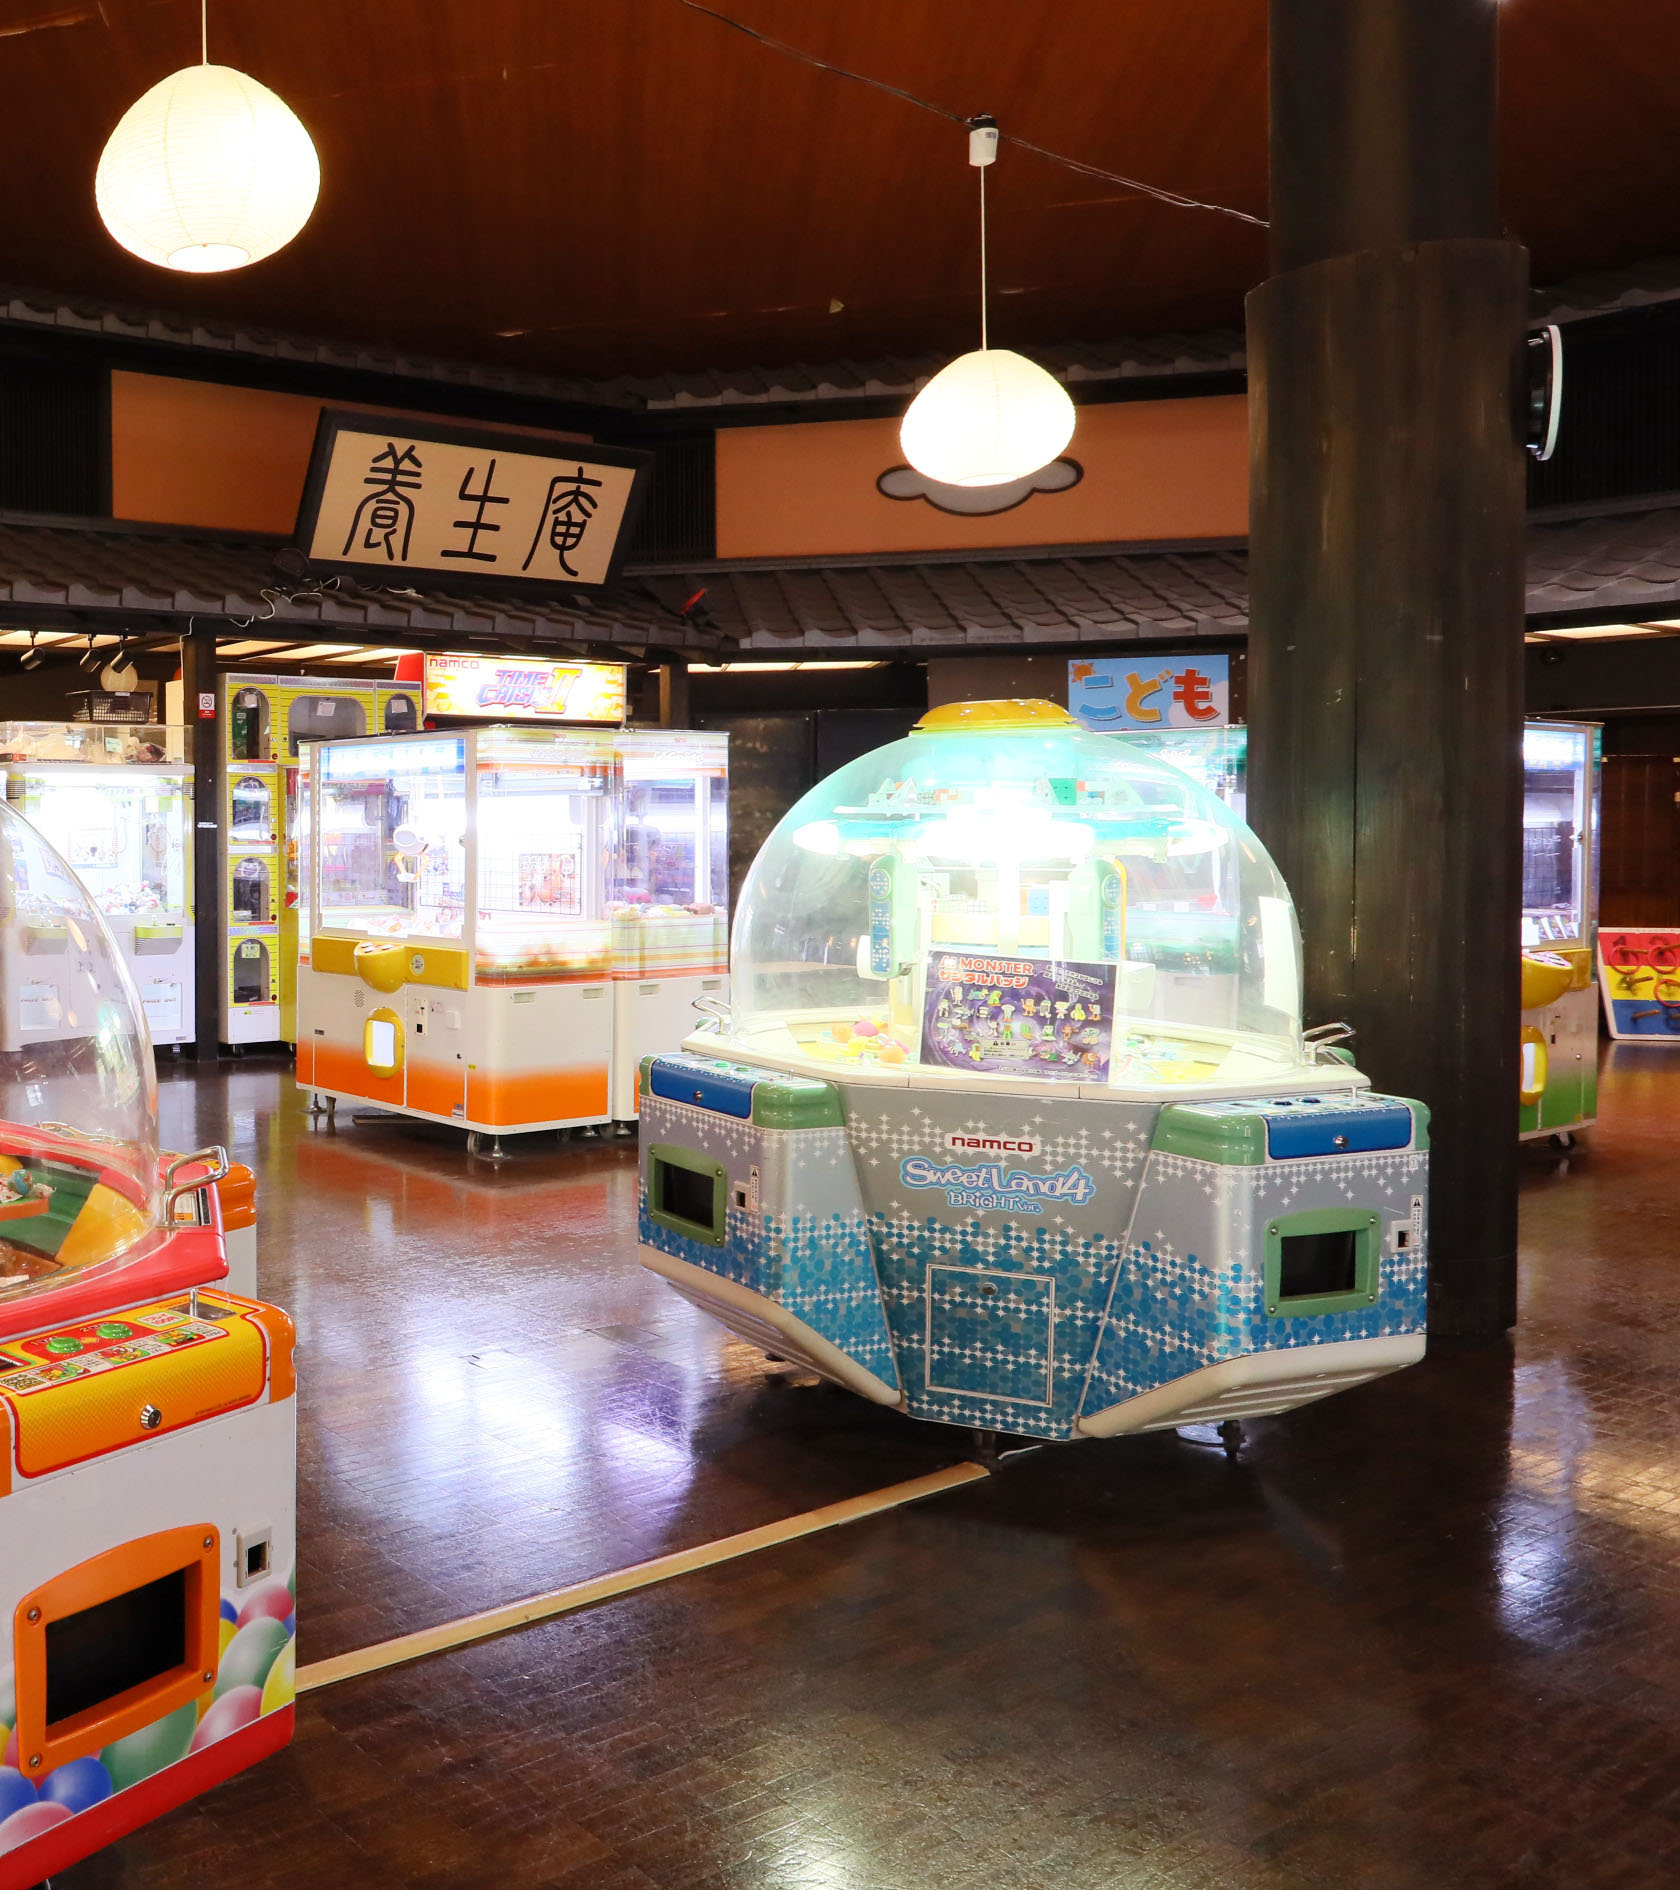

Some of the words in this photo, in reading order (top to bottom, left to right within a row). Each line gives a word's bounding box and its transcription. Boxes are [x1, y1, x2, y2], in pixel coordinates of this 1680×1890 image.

[341, 441, 603, 577] 養生庵
[429, 657, 480, 670] namco
[494, 669, 550, 687] TIME
[1079, 668, 1221, 723] こども
[960, 957, 1033, 975] MONSTER
[951, 1136, 1033, 1152] namco
